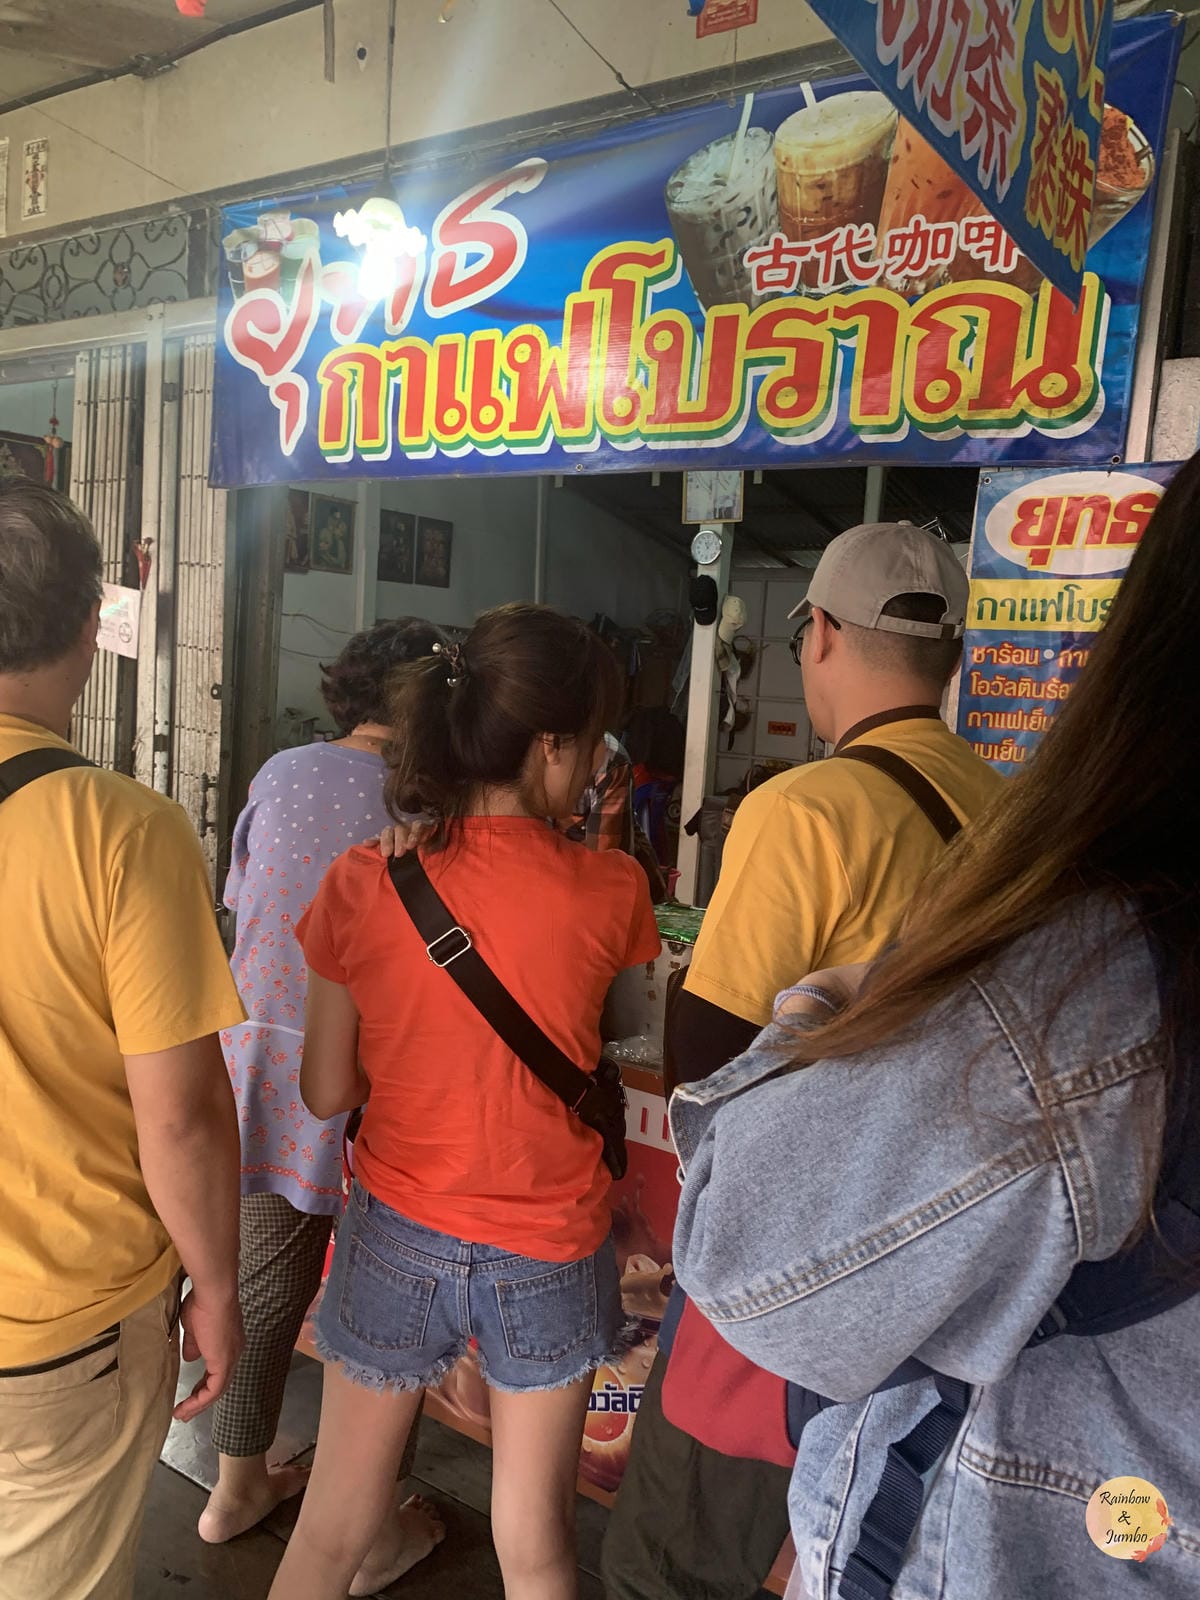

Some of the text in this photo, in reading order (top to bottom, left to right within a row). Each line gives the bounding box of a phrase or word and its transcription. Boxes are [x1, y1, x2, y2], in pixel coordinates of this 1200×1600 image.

[318, 238, 1110, 464] กาแฟโบราณ
[972, 640, 1040, 666] ชาร้อน
[970, 671, 1073, 700] โอวัลตินร้อ
